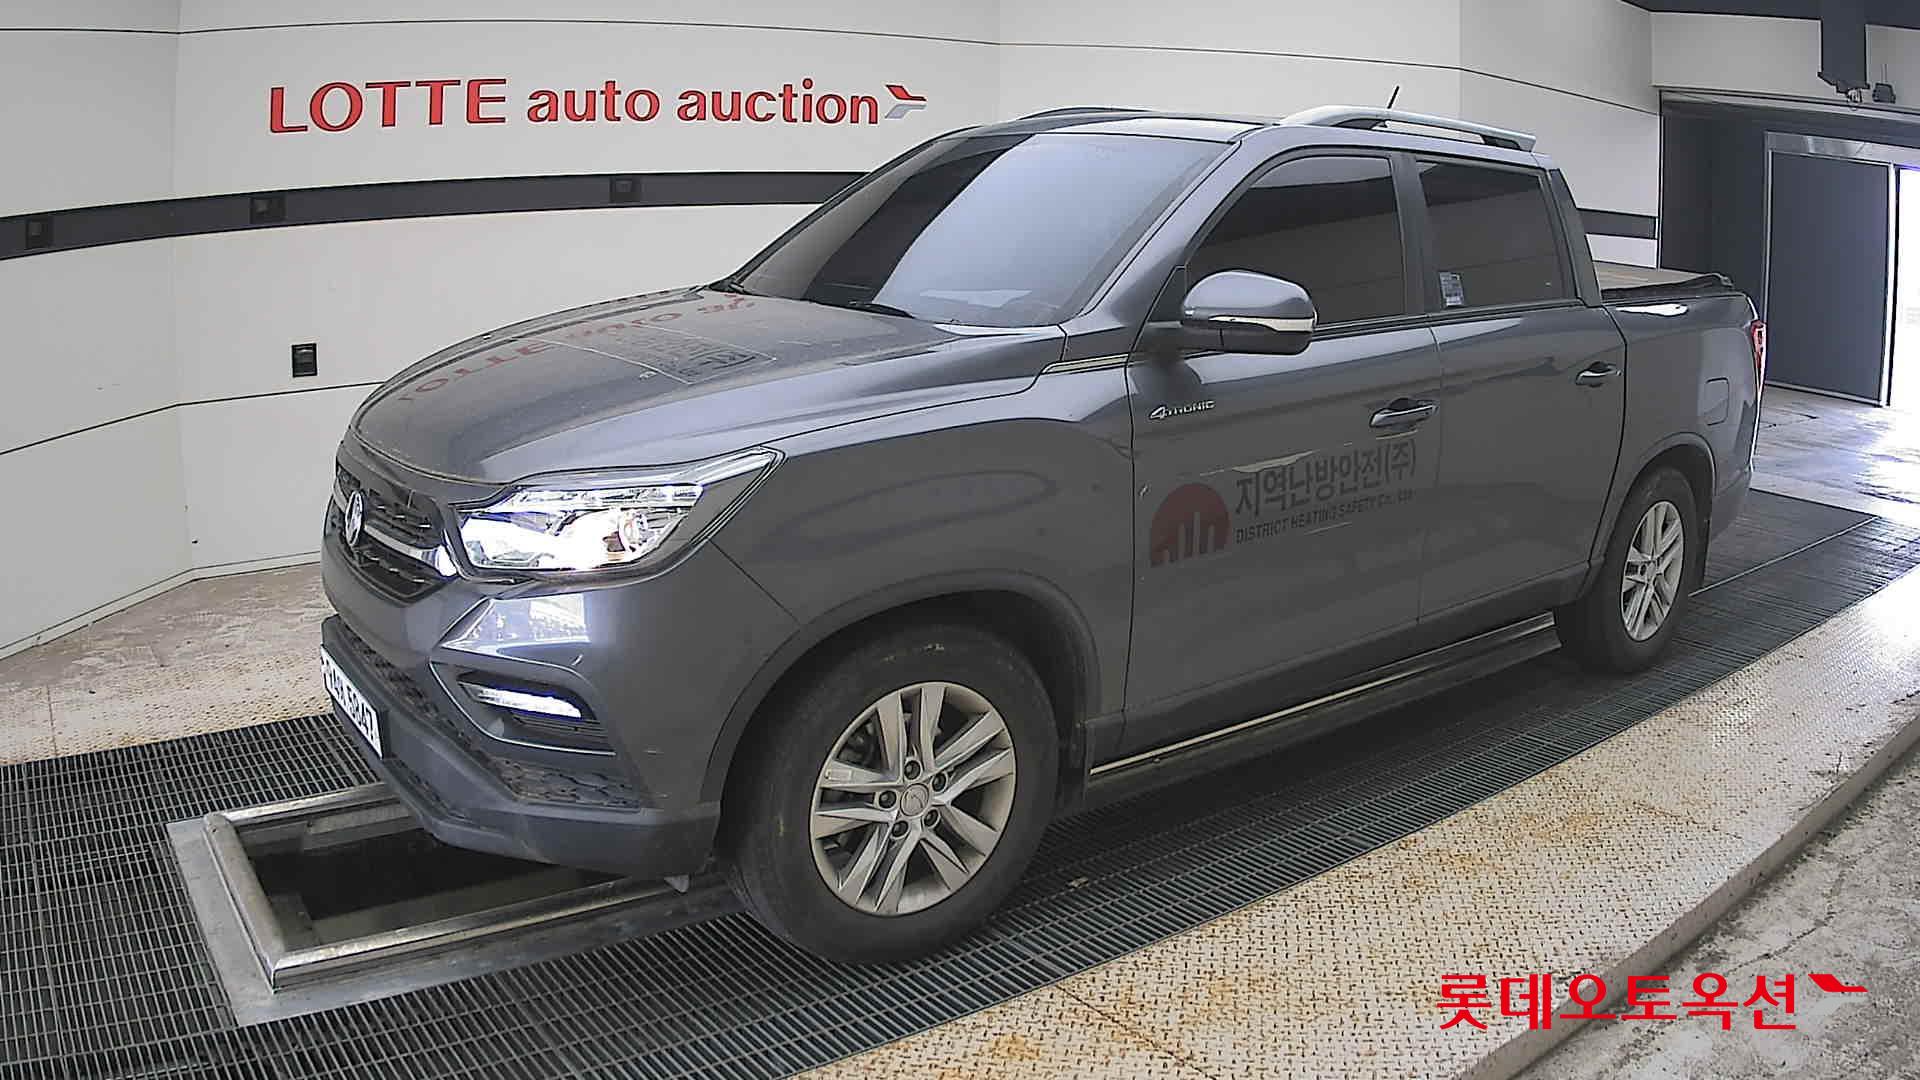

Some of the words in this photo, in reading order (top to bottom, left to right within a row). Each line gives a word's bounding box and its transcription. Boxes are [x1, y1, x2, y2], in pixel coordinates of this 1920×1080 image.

[269, 78, 507, 134] LOTTE
[526, 79, 660, 123] auto
[675, 78, 879, 124] auction
[1234, 438, 1416, 516] 지역난방안전(주)
[1235, 517, 1289, 545] DISTRICT
